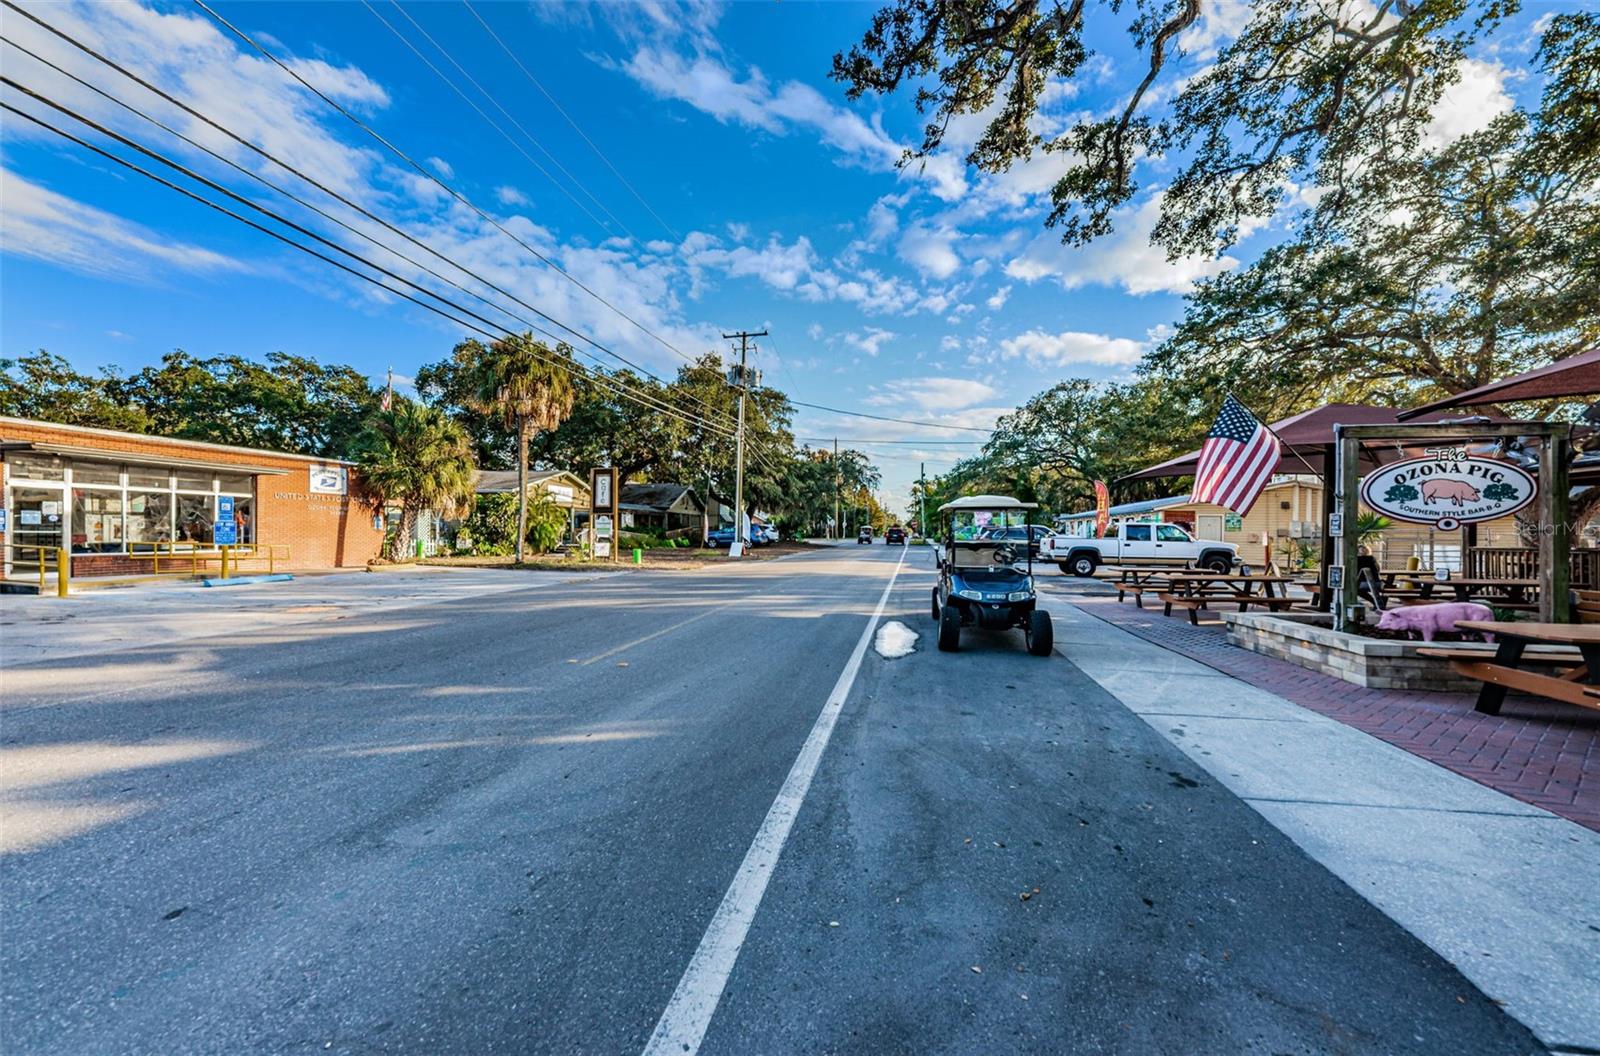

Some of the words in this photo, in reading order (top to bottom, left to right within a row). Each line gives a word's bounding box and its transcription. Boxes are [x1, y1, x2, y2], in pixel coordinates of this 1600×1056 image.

[1424, 446, 1467, 462] The
[1394, 463, 1463, 484] OZONA
[1467, 464, 1505, 484] PIG
[273, 492, 304, 500] UNITED
[305, 493, 331, 502] STATES
[1399, 503, 1440, 517] SOUTHERN
[1442, 509, 1466, 517] STYLE
[1468, 502, 1502, 515] BAR-B-Q
